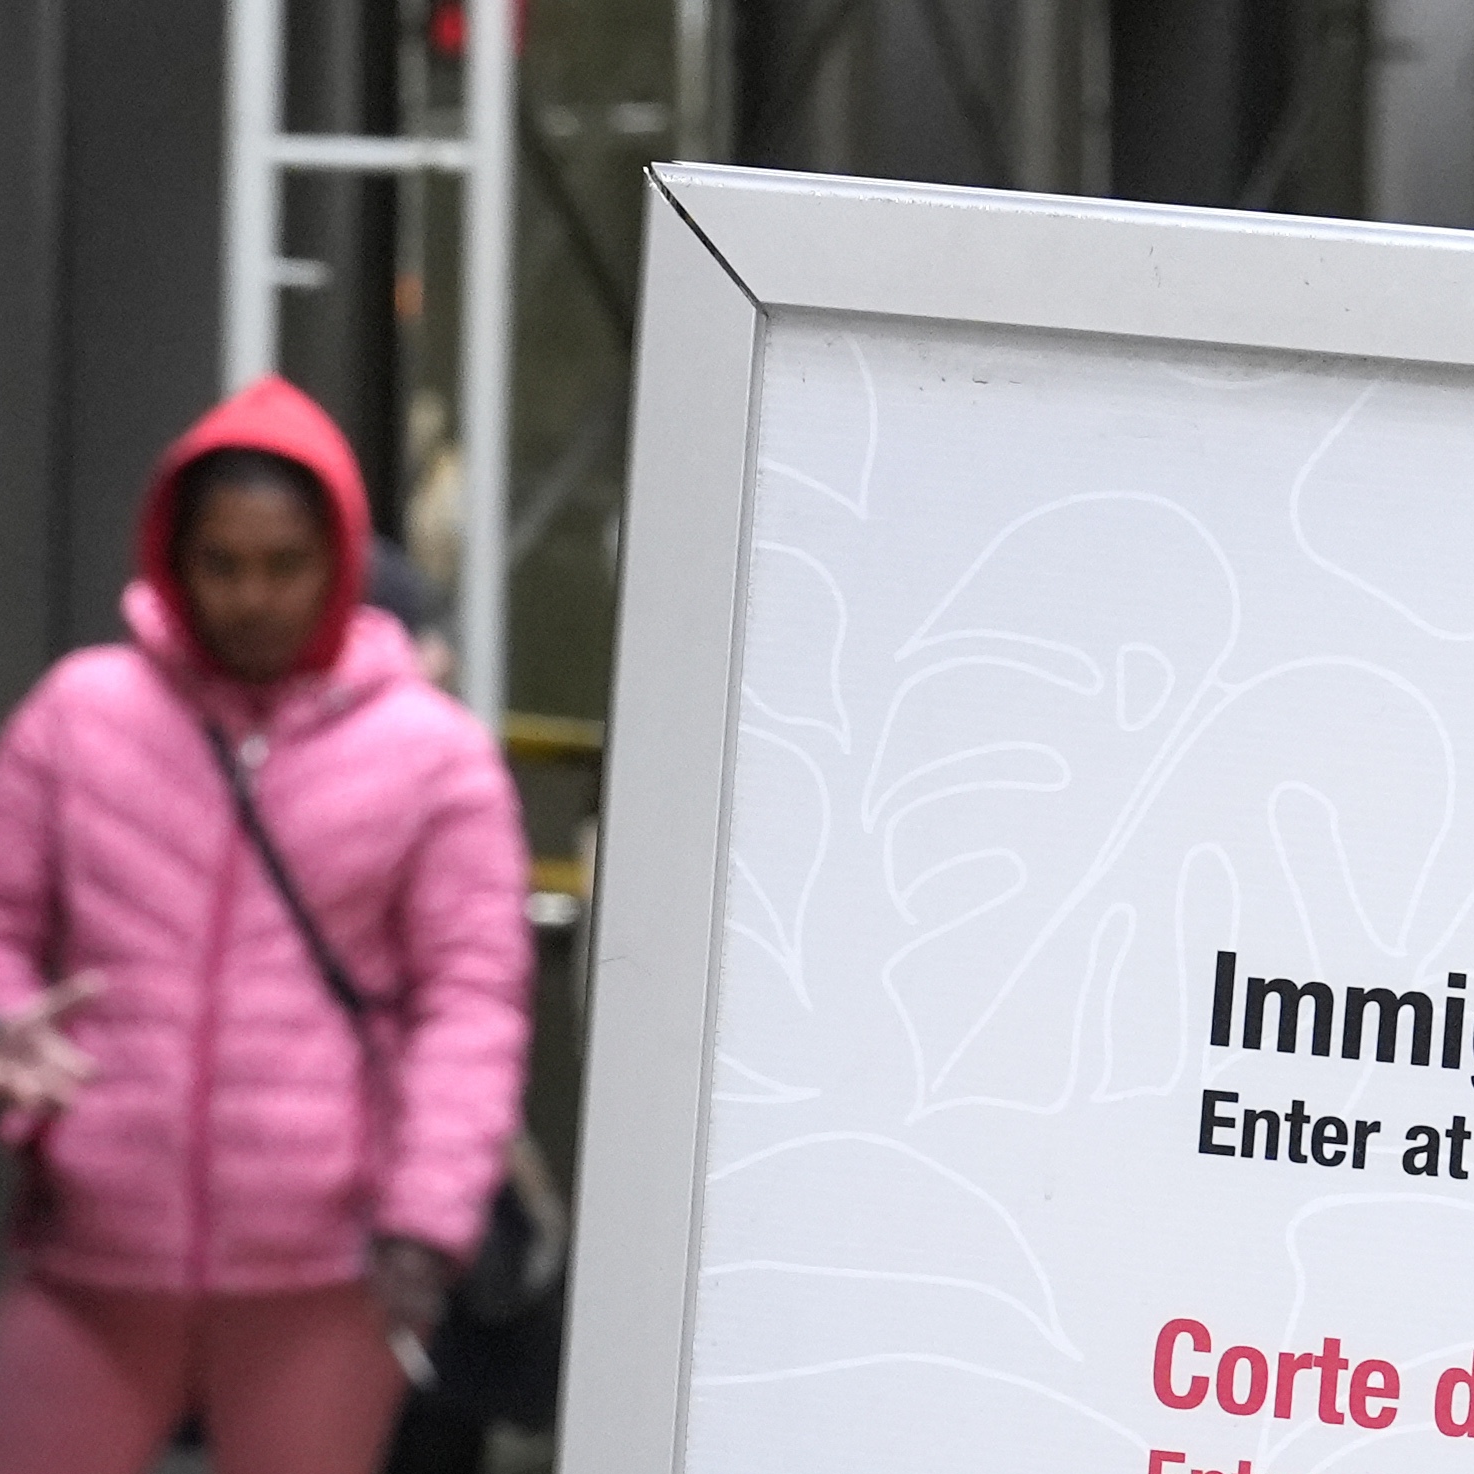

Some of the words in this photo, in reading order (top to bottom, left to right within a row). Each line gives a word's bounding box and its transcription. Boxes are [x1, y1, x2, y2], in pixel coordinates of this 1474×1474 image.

[1197, 1088, 1382, 1170] Enter
[1401, 1115, 1472, 1180] at
[1153, 1318, 1401, 1430] Corte
